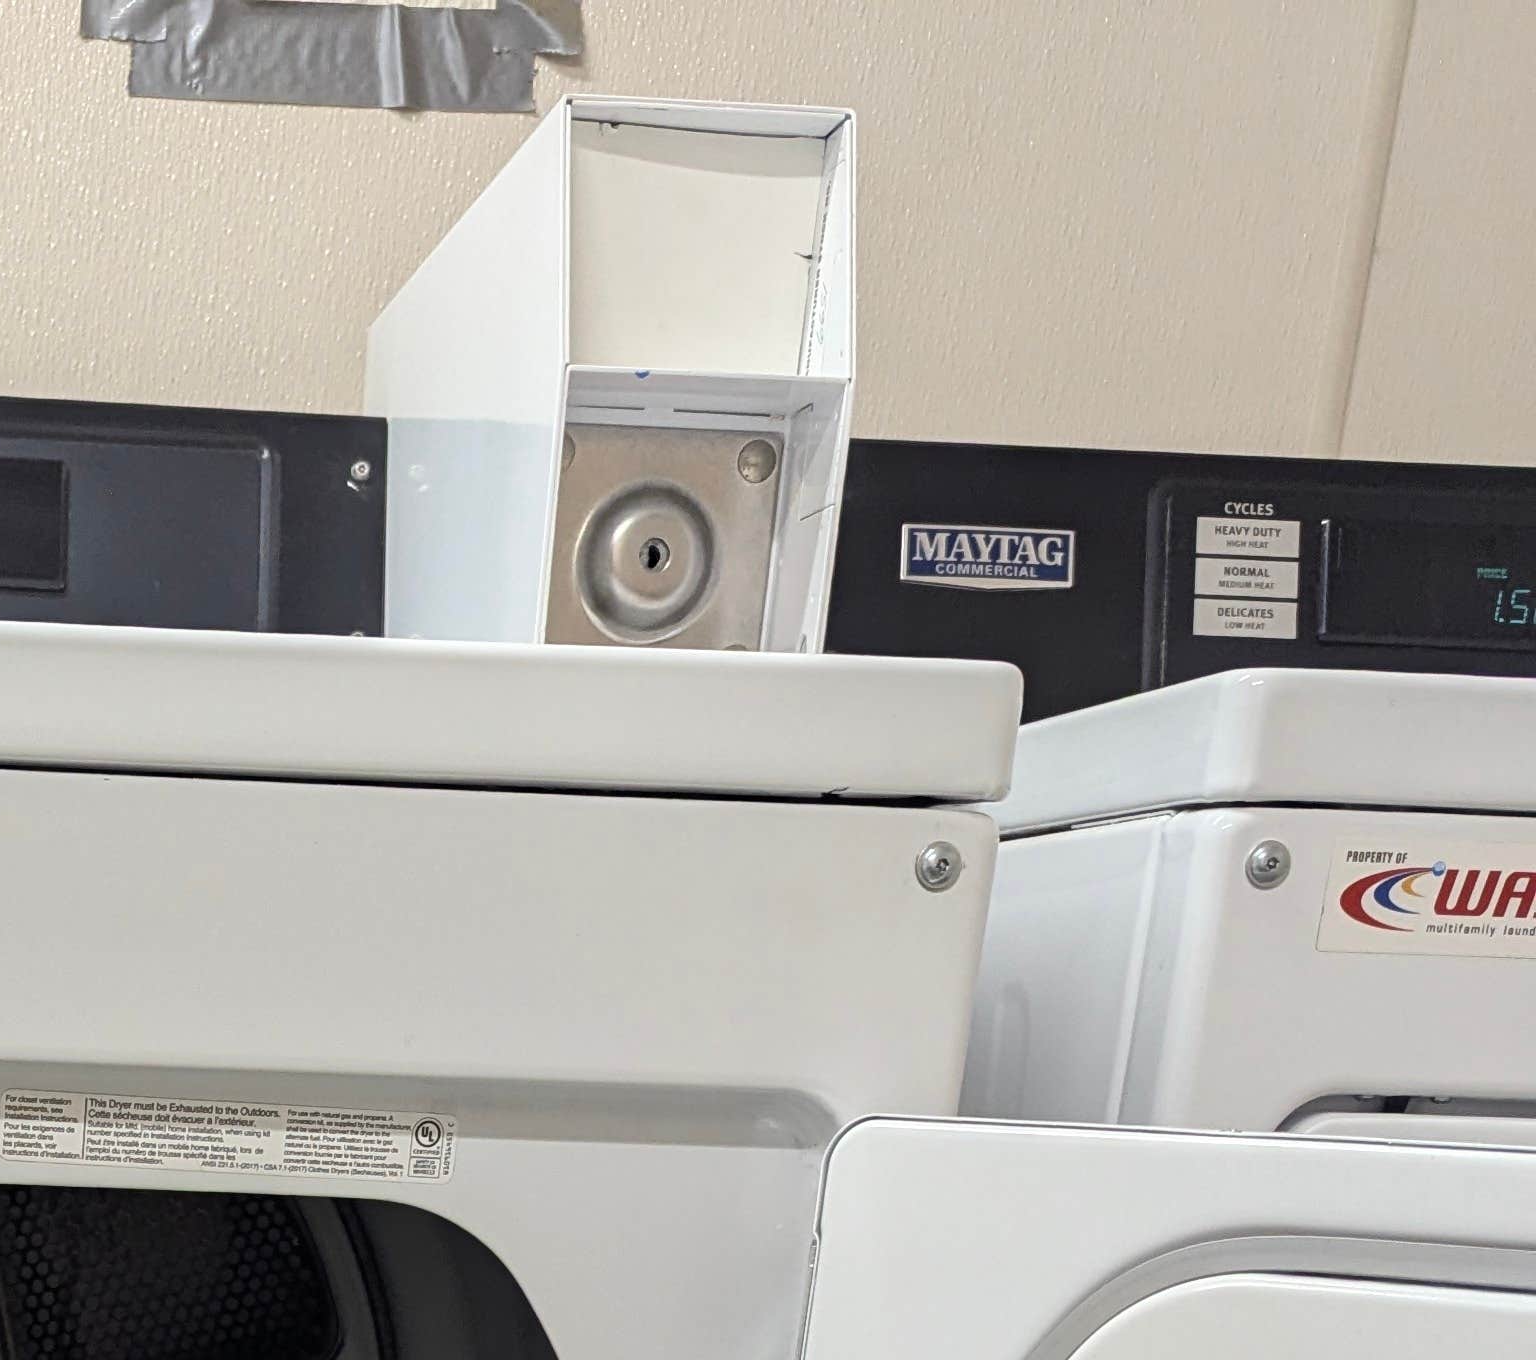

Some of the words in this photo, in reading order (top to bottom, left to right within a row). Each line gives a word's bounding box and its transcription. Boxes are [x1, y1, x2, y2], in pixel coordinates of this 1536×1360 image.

[1224, 501, 1274, 517] CYCLES
[1214, 524, 1249, 538] HEAVY
[1253, 526, 1282, 539] DUTY
[913, 532, 1063, 566] MAYTAG
[1226, 539, 1246, 549] HIGH
[1248, 540, 1269, 550] HEAT
[935, 562, 1037, 578] COMMERCIAL
[1223, 565, 1270, 579] NORMAL
[1218, 579, 1250, 590] MEDIUM
[1252, 580, 1275, 591] HEAT
[1217, 606, 1274, 620] DELICATES
[1224, 620, 1242, 630] LOW
[1244, 621, 1265, 631] HEAT
[1346, 851, 1394, 864] PROPERTY
[1395, 852, 1408, 865] OF
[1434, 869, 1536, 919] WA
[1426, 923, 1496, 938] multifamily
[89, 1098, 107, 1108] This
[109, 1099, 131, 1111] Dryer
[134, 1102, 155, 1111] must
[156, 1103, 167, 1112] be
[169, 1103, 213, 1114] Exhausted
[215, 1106, 224, 1115] to
[225, 1106, 238, 1116] the
[240, 1107, 280, 1118] Outdoors.
